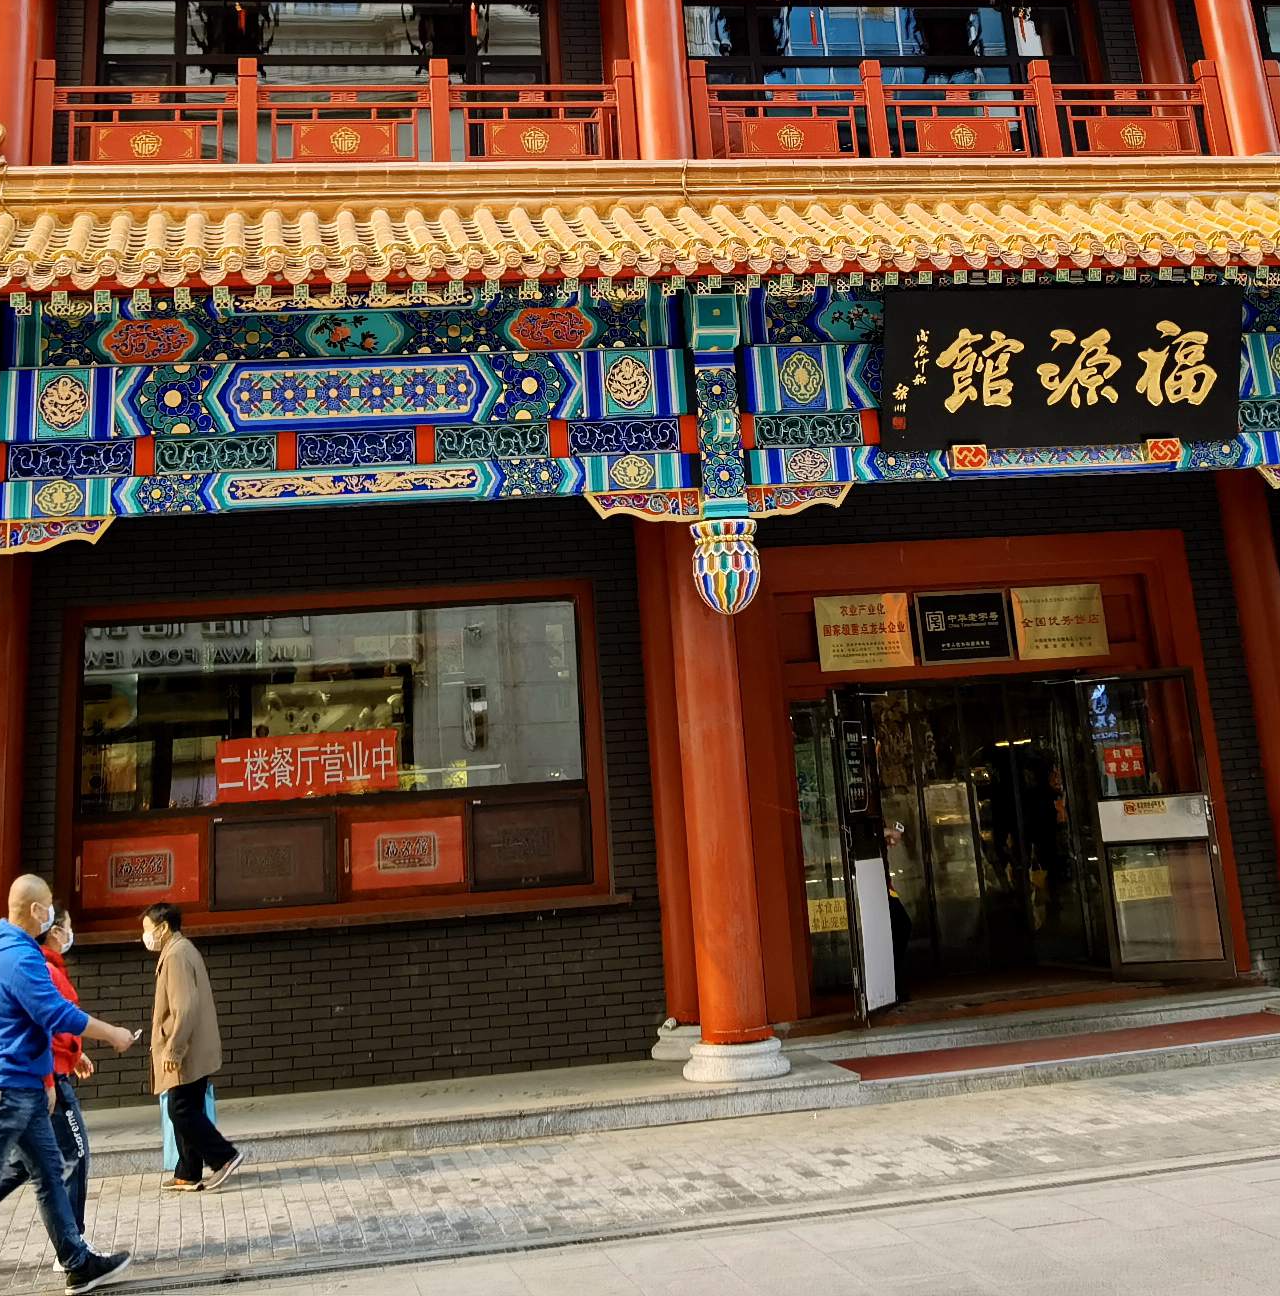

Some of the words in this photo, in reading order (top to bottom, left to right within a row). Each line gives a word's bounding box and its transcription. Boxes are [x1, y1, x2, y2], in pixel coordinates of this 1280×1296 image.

[219, 738, 397, 793] 二楼餐厅营业中
